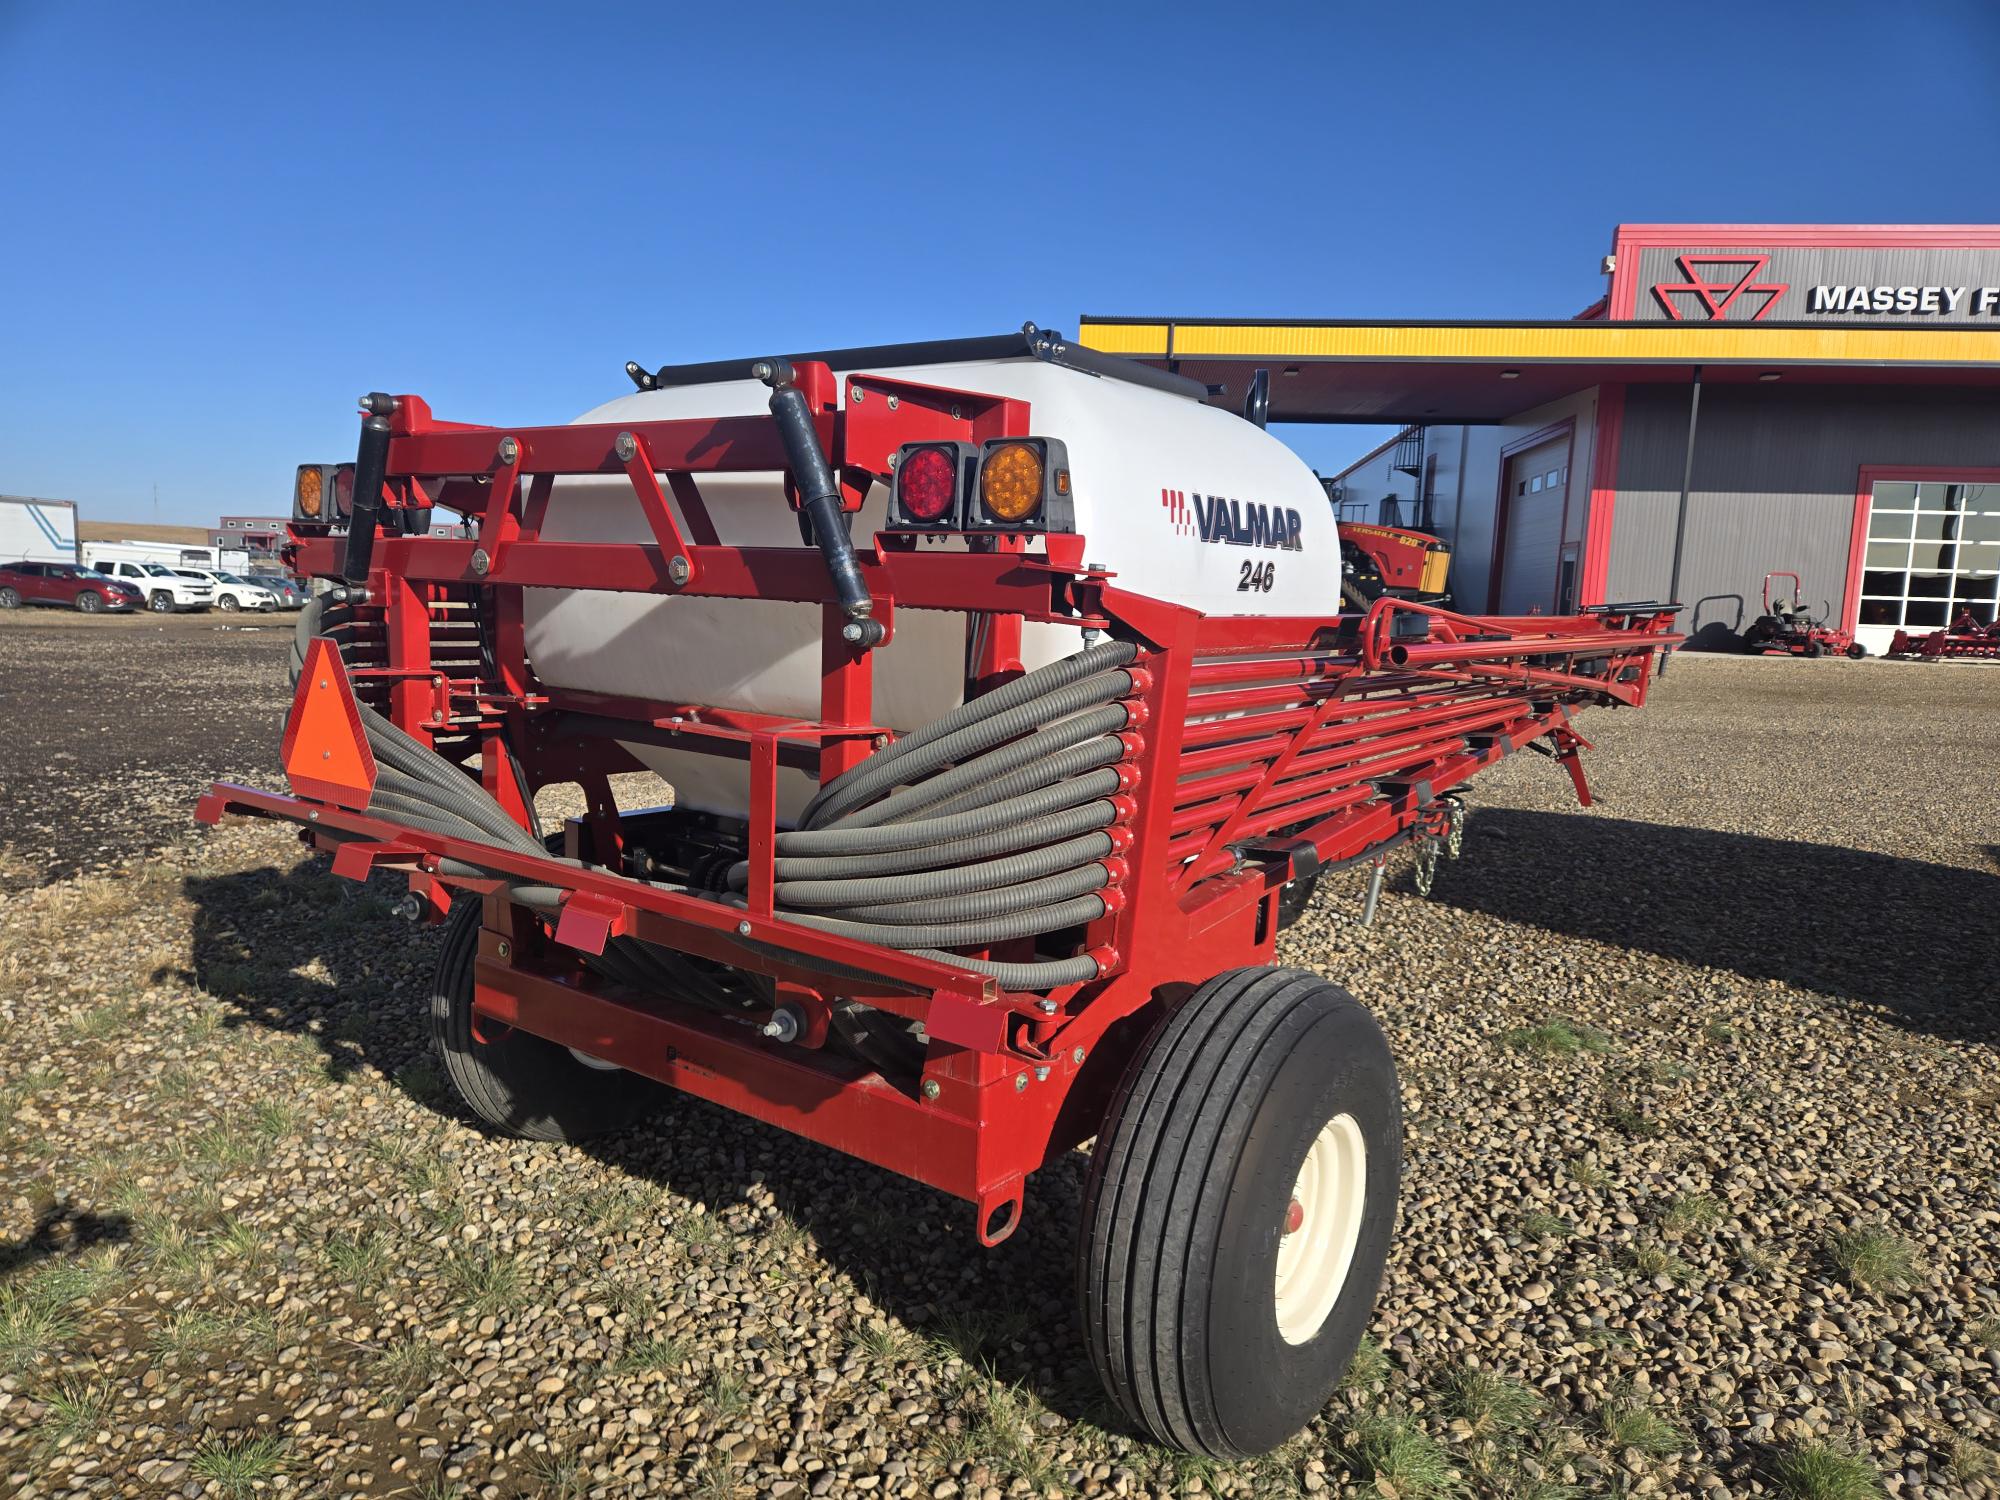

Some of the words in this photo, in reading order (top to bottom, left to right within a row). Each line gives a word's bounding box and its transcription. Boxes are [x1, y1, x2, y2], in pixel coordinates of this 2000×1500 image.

[1813, 285, 1967, 312] MASSEY
[1192, 492, 1303, 552] VALMAR
[1399, 535, 1418, 548] 620
[1236, 559, 1276, 593] 246
